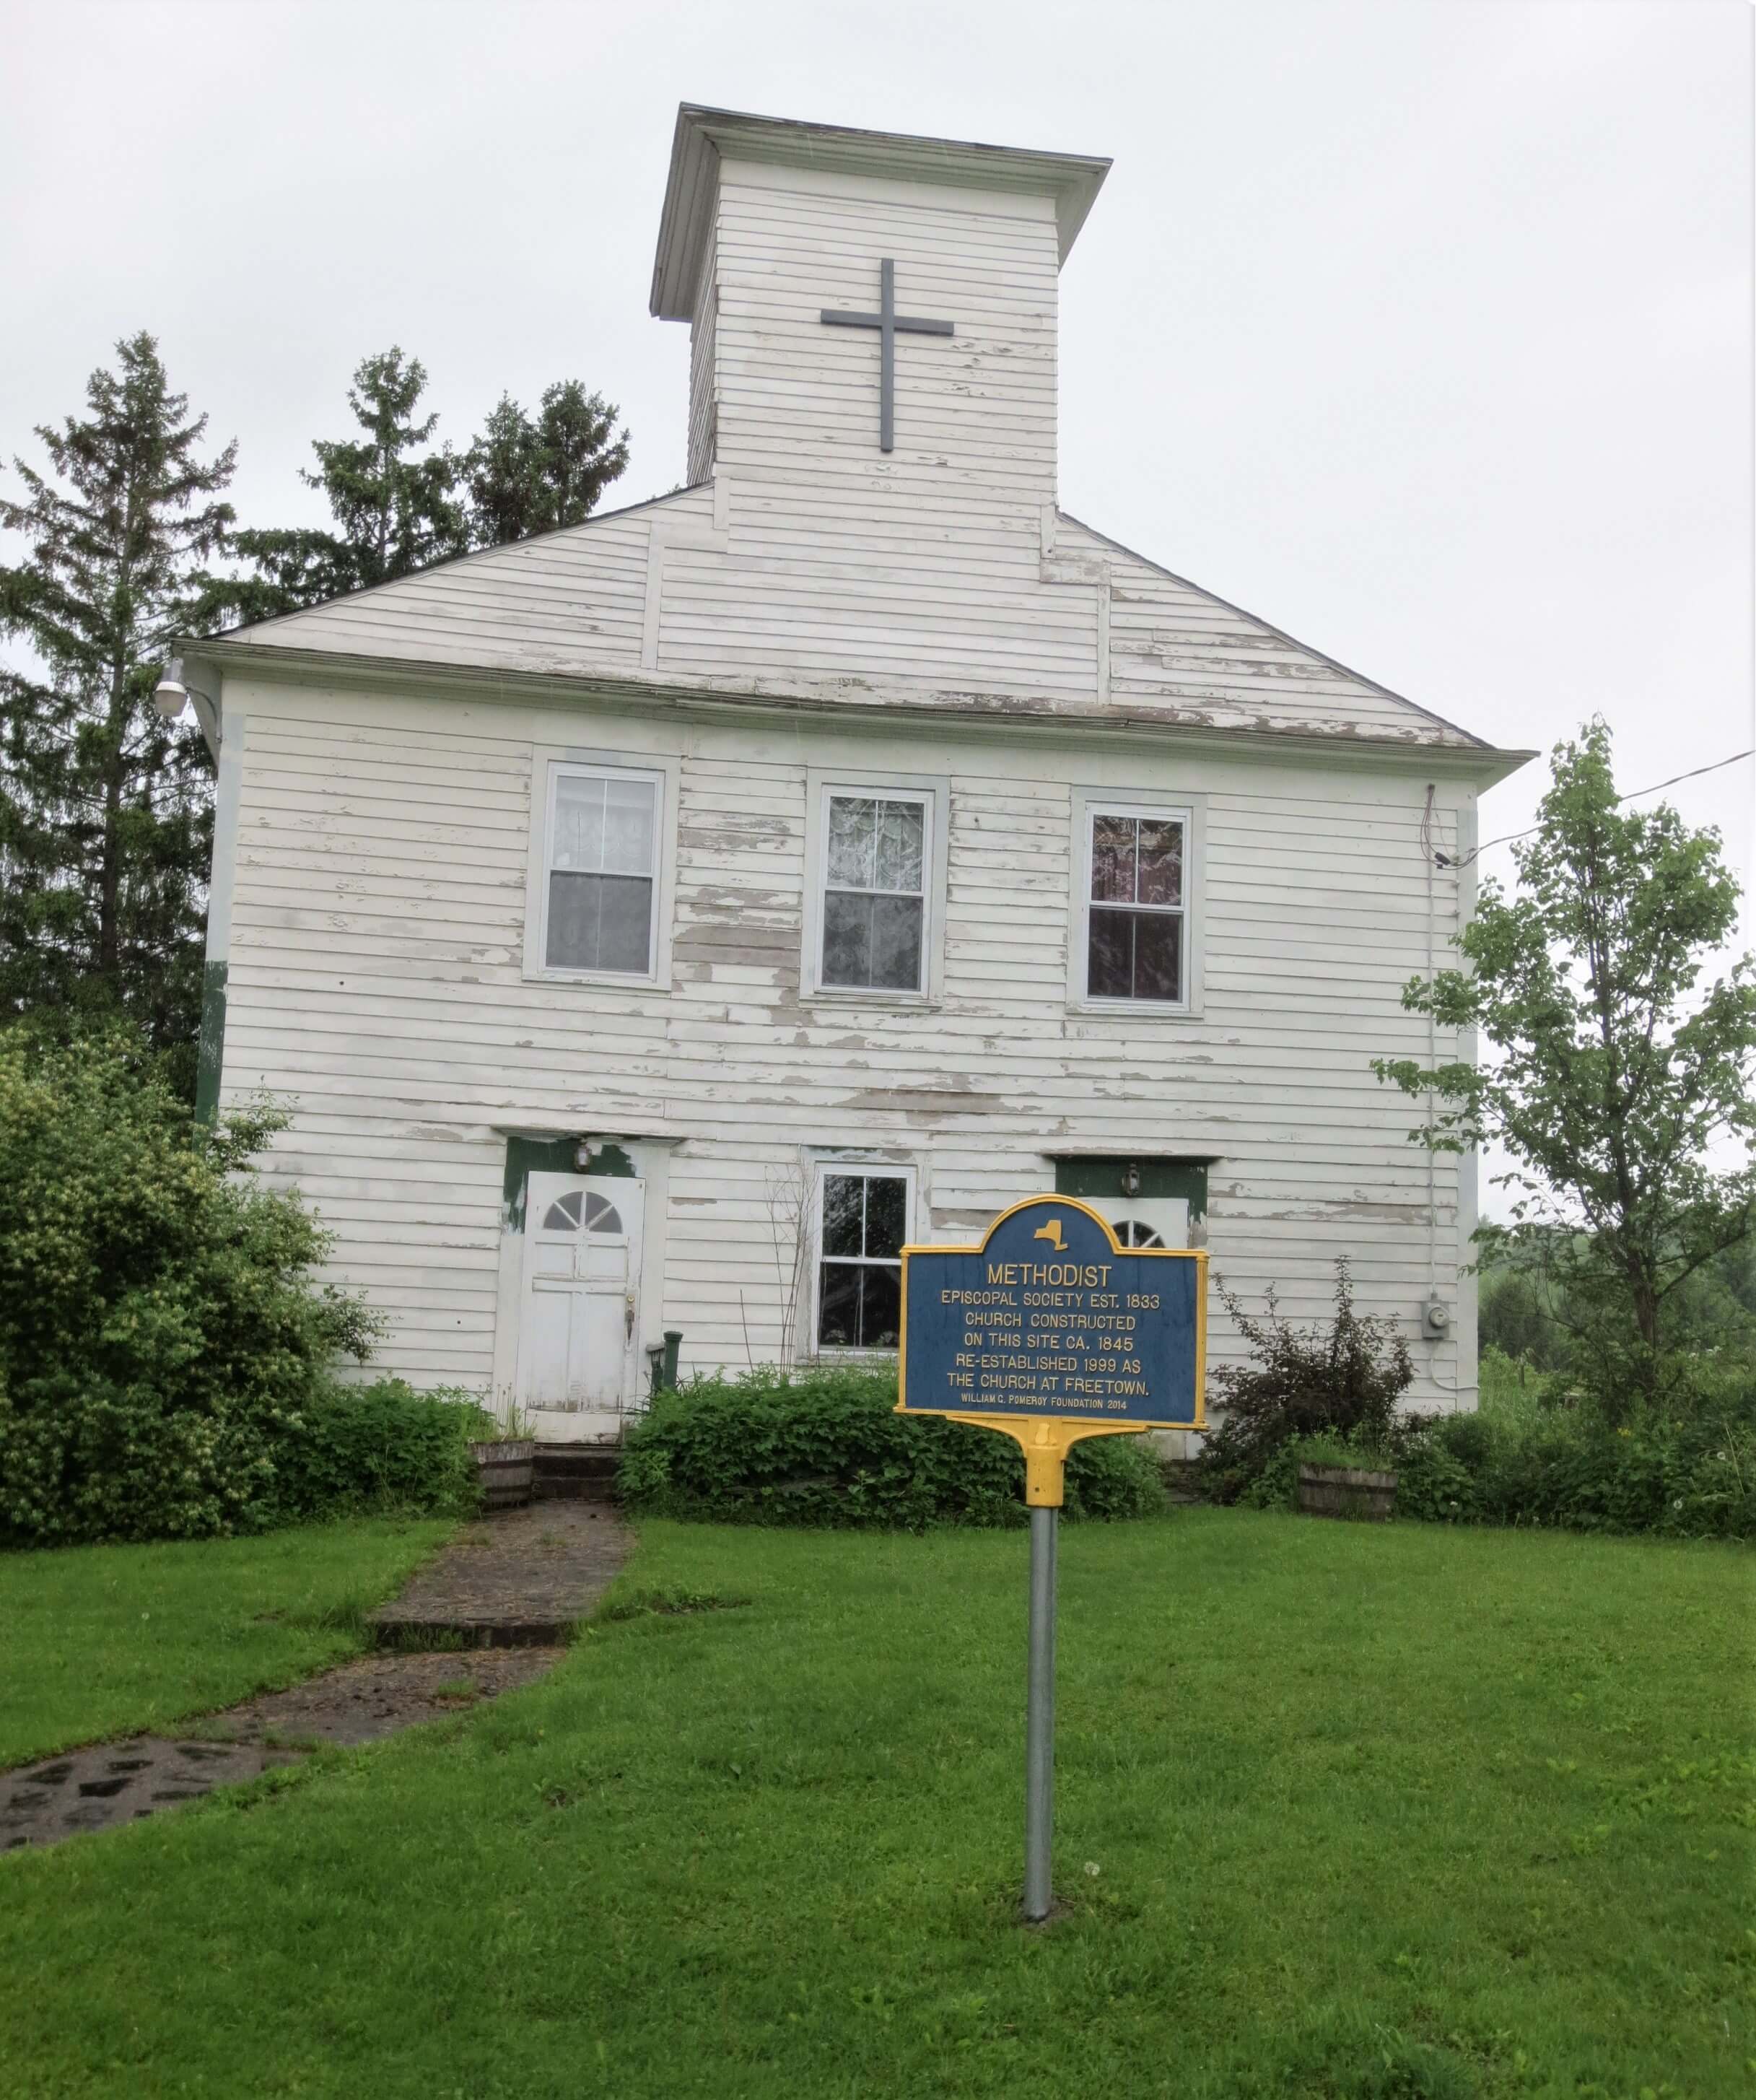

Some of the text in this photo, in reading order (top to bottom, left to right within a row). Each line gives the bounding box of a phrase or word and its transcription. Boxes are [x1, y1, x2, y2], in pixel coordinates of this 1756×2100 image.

[987, 1263, 1111, 1288] METHODIST
[941, 1290, 1161, 1310] EPISCOPAL SOCIETY EST. 1833
[965, 1312, 1136, 1330] CHURCH CONSTRUCTED
[964, 1333, 1133, 1352] ON THIS SITE CA. 1845
[956, 1353, 1141, 1374] RE-ESTABLISHED 1999 AS
[948, 1373, 1150, 1396] THE CHURCH AT FREETOWN.
[961, 1393, 1127, 1410] WILLIAM G. POMEROY FOUNDATION 2014
